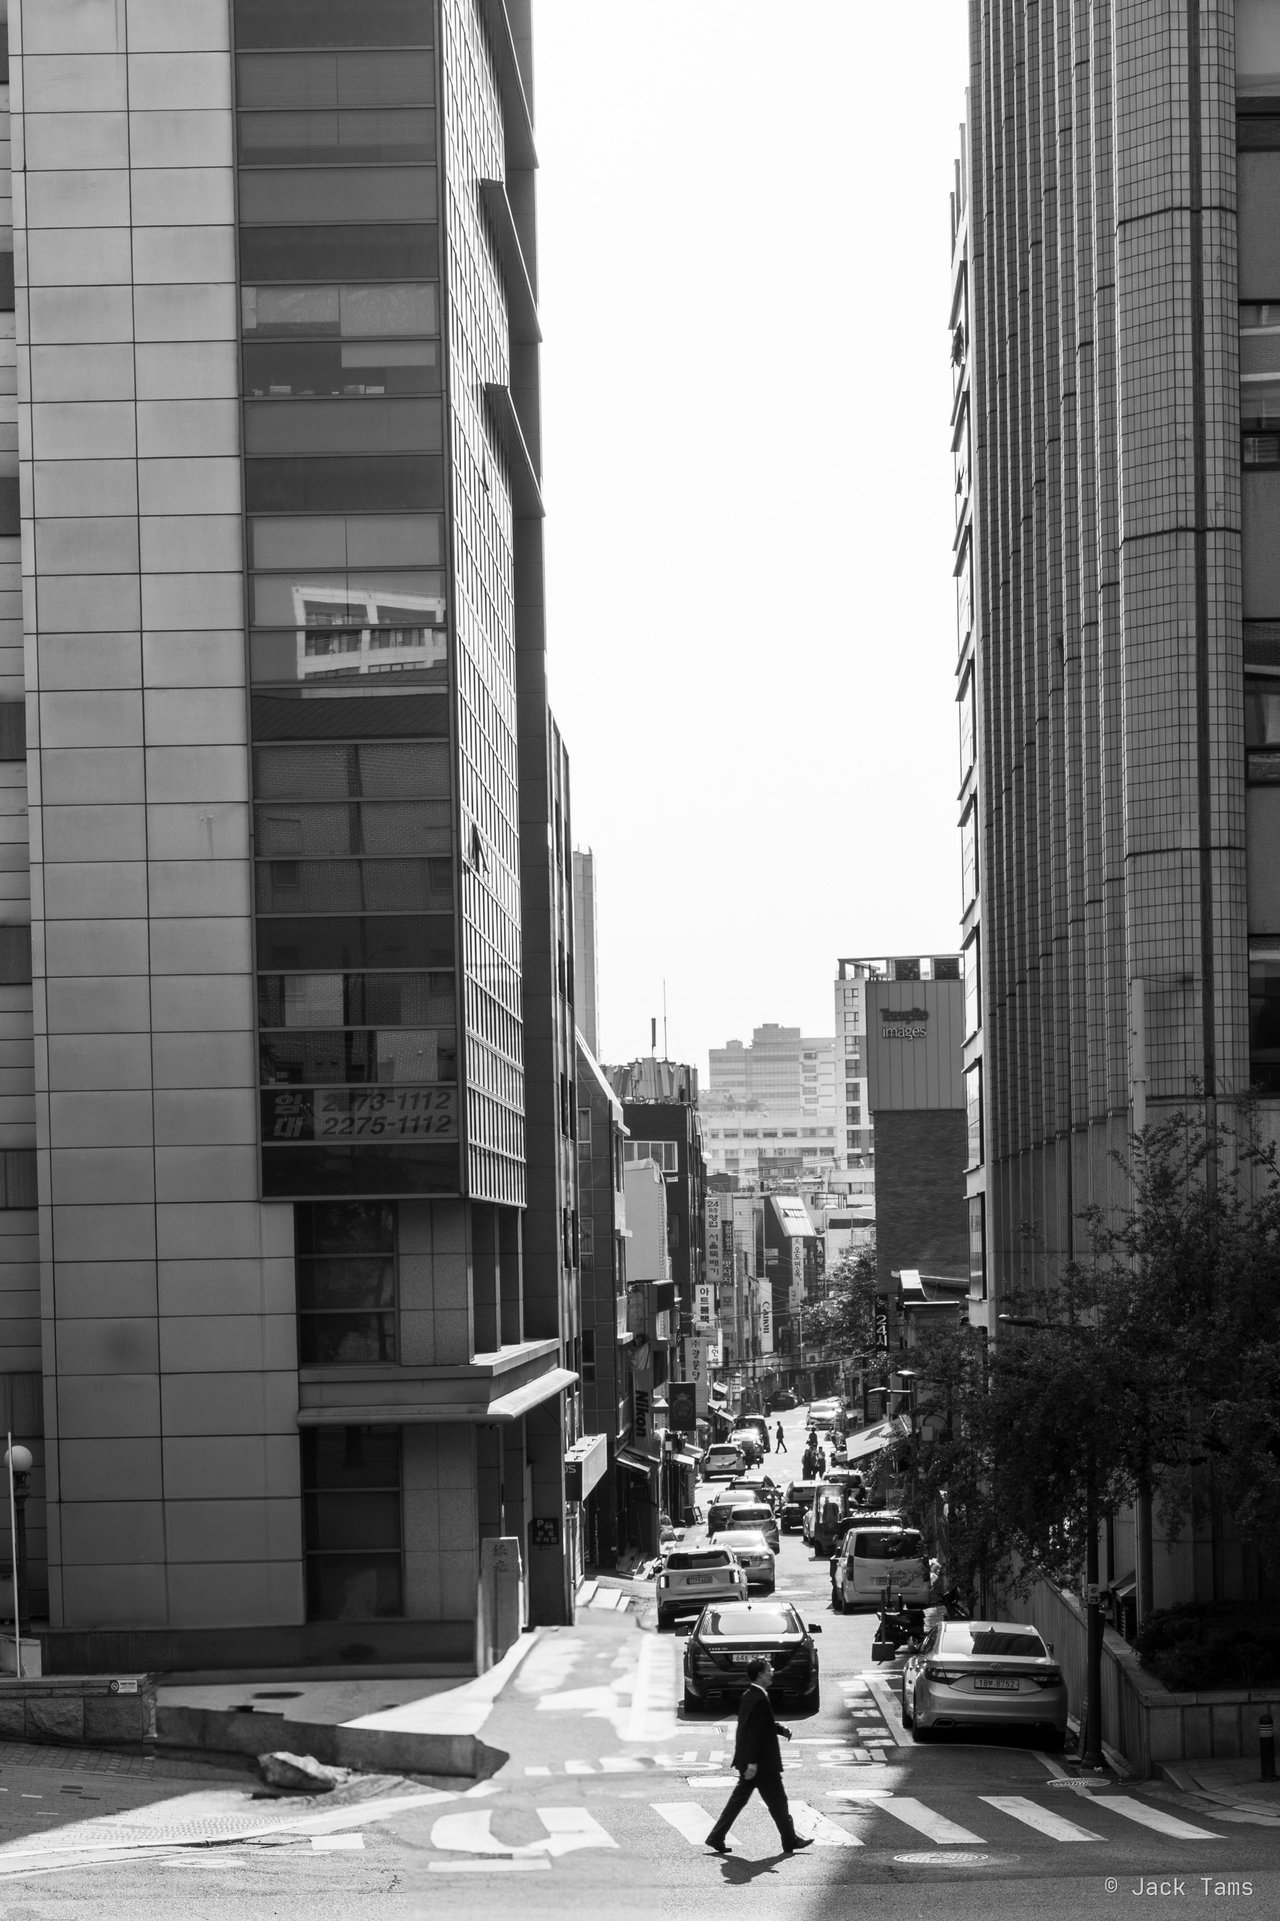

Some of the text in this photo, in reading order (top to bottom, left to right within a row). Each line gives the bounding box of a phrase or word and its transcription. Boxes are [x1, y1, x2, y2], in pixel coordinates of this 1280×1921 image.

[882, 1025, 927, 1040] images
[322, 1092, 451, 1112] 273-1112
[322, 1115, 452, 1135] 2275-1112
[762, 1301, 770, 1334] Canon
[635, 1390, 649, 1438] Nikon
